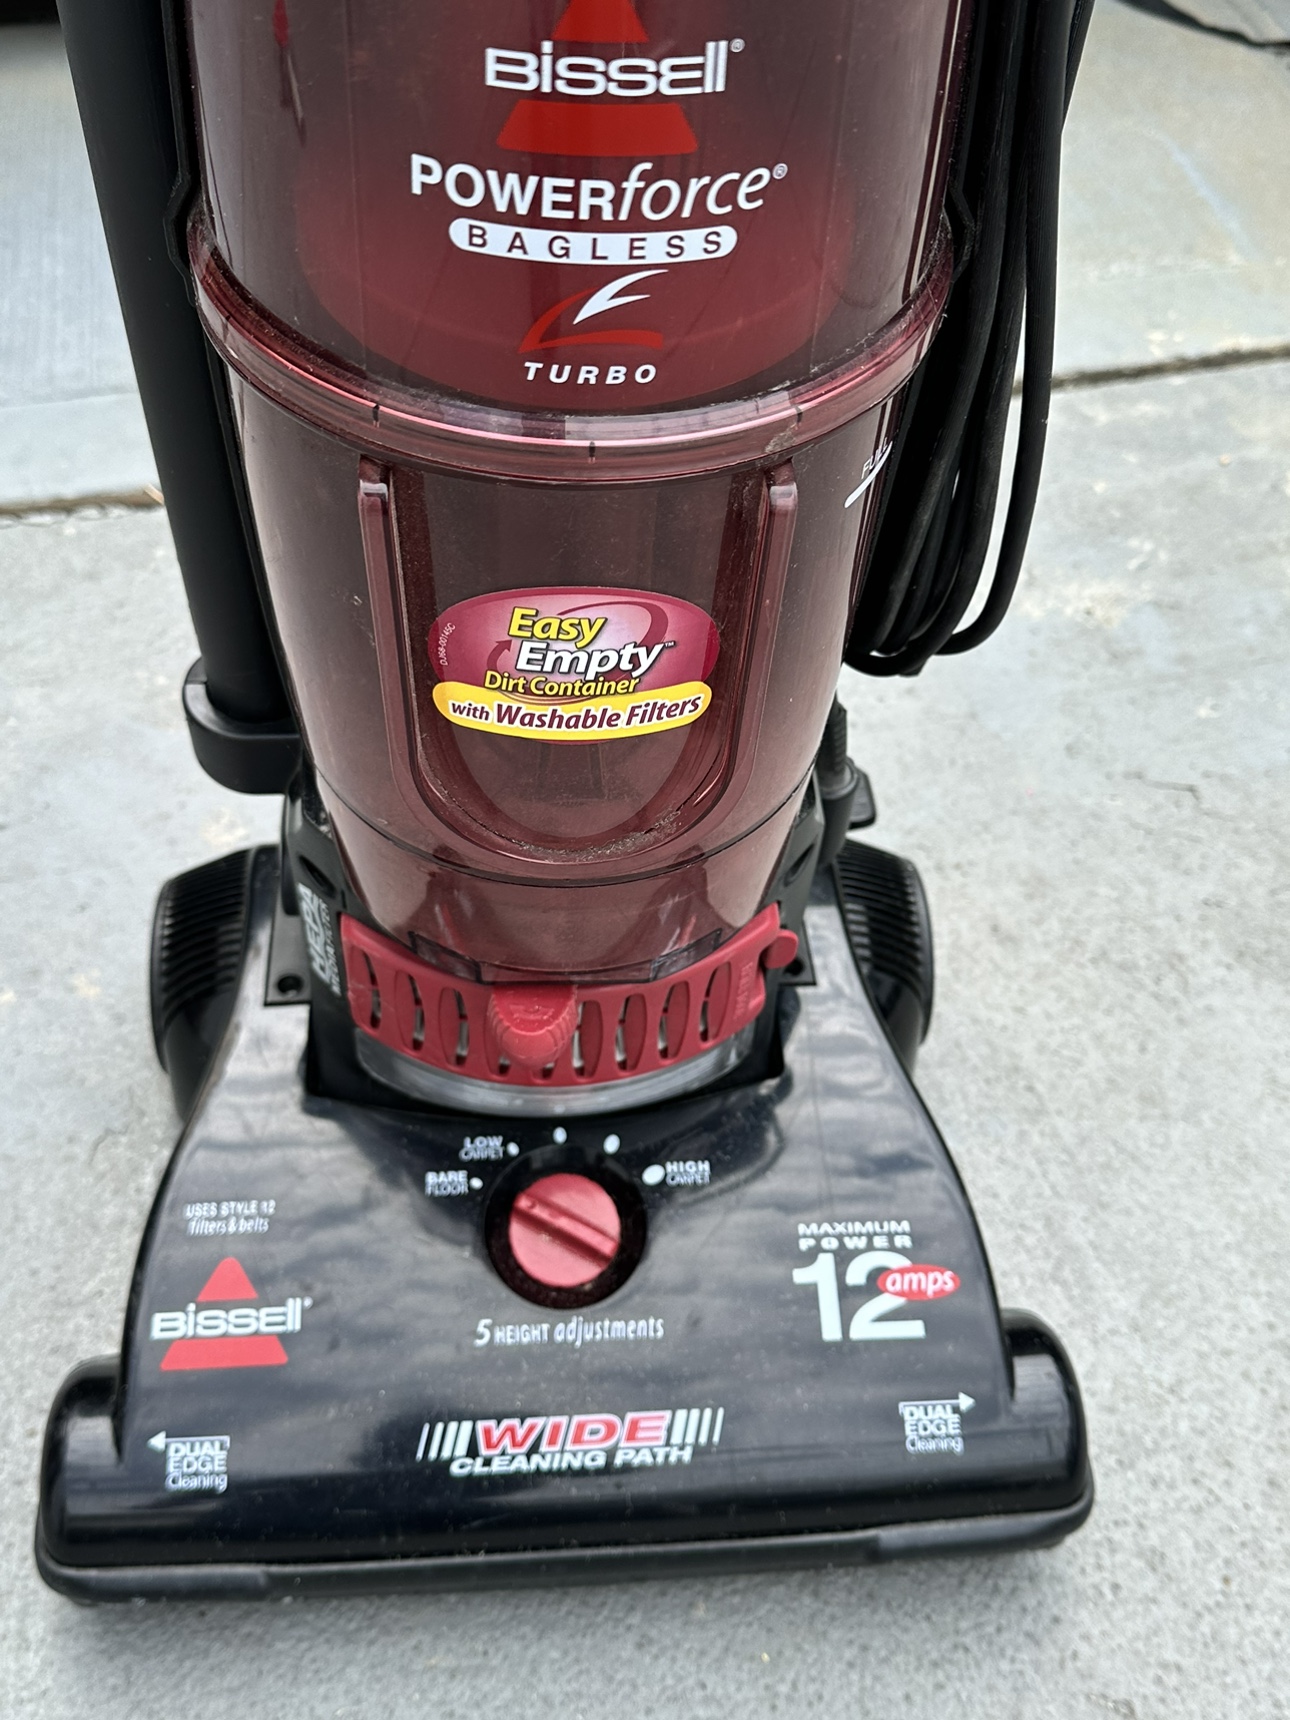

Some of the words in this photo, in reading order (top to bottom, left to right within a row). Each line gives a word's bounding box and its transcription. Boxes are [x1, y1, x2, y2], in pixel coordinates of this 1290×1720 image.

[467, 224, 722, 260] BAGLESS
[524, 362, 657, 385] TURBO
[508, 607, 606, 647] Easy
[515, 640, 664, 680] Empty
[484, 670, 526, 693] Dirt
[530, 676, 640, 697] Container
[451, 700, 490, 722] with
[495, 703, 621, 730] Washable
[626, 695, 701, 726] Filters
[463, 1135, 503, 1148] LOW
[425, 1170, 468, 1183] BARE
[665, 1160, 711, 1173] HIGH
[184, 1202, 218, 1219] USES
[219, 1200, 258, 1217] STYLE
[797, 1220, 911, 1235] MAXIMUM
[799, 1235, 912, 1250] POWER
[886, 1271, 955, 1297] amps
[793, 1251, 925, 1341] 12
[474, 1319, 492, 1346] 5
[494, 1322, 549, 1345] HEIGHT
[553, 1315, 664, 1348] adjustments
[904, 1405, 960, 1421] DUAL
[476, 1410, 672, 1455] WIDE
[905, 1419, 961, 1438] EDGE
[167, 1441, 227, 1457] DUAL
[167, 1455, 227, 1474] EDGE
[450, 1453, 606, 1477] CLEANING
[613, 1446, 692, 1467] PATH
[165, 1472, 228, 1494] Cleaning
